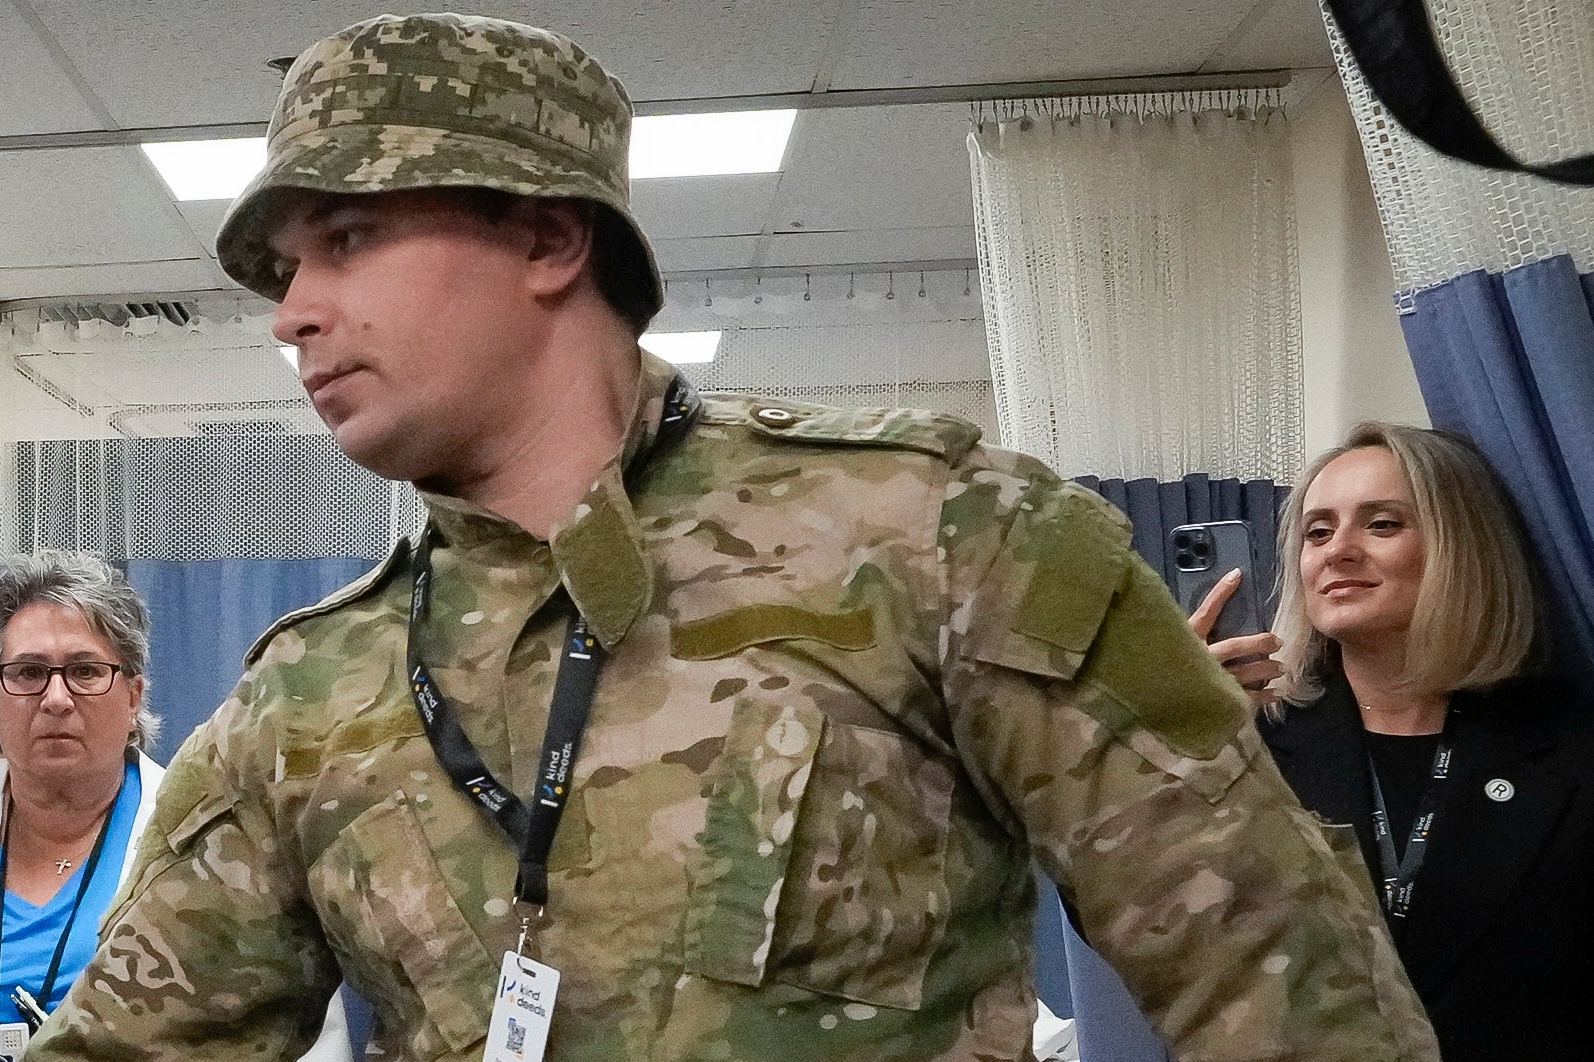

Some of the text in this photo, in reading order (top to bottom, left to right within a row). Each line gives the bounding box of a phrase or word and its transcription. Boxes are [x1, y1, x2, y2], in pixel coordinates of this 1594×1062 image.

[546, 750, 561, 781] kind
[1492, 783, 1508, 797] R
[519, 984, 541, 1001] kind
[516, 997, 546, 1017] deeds
